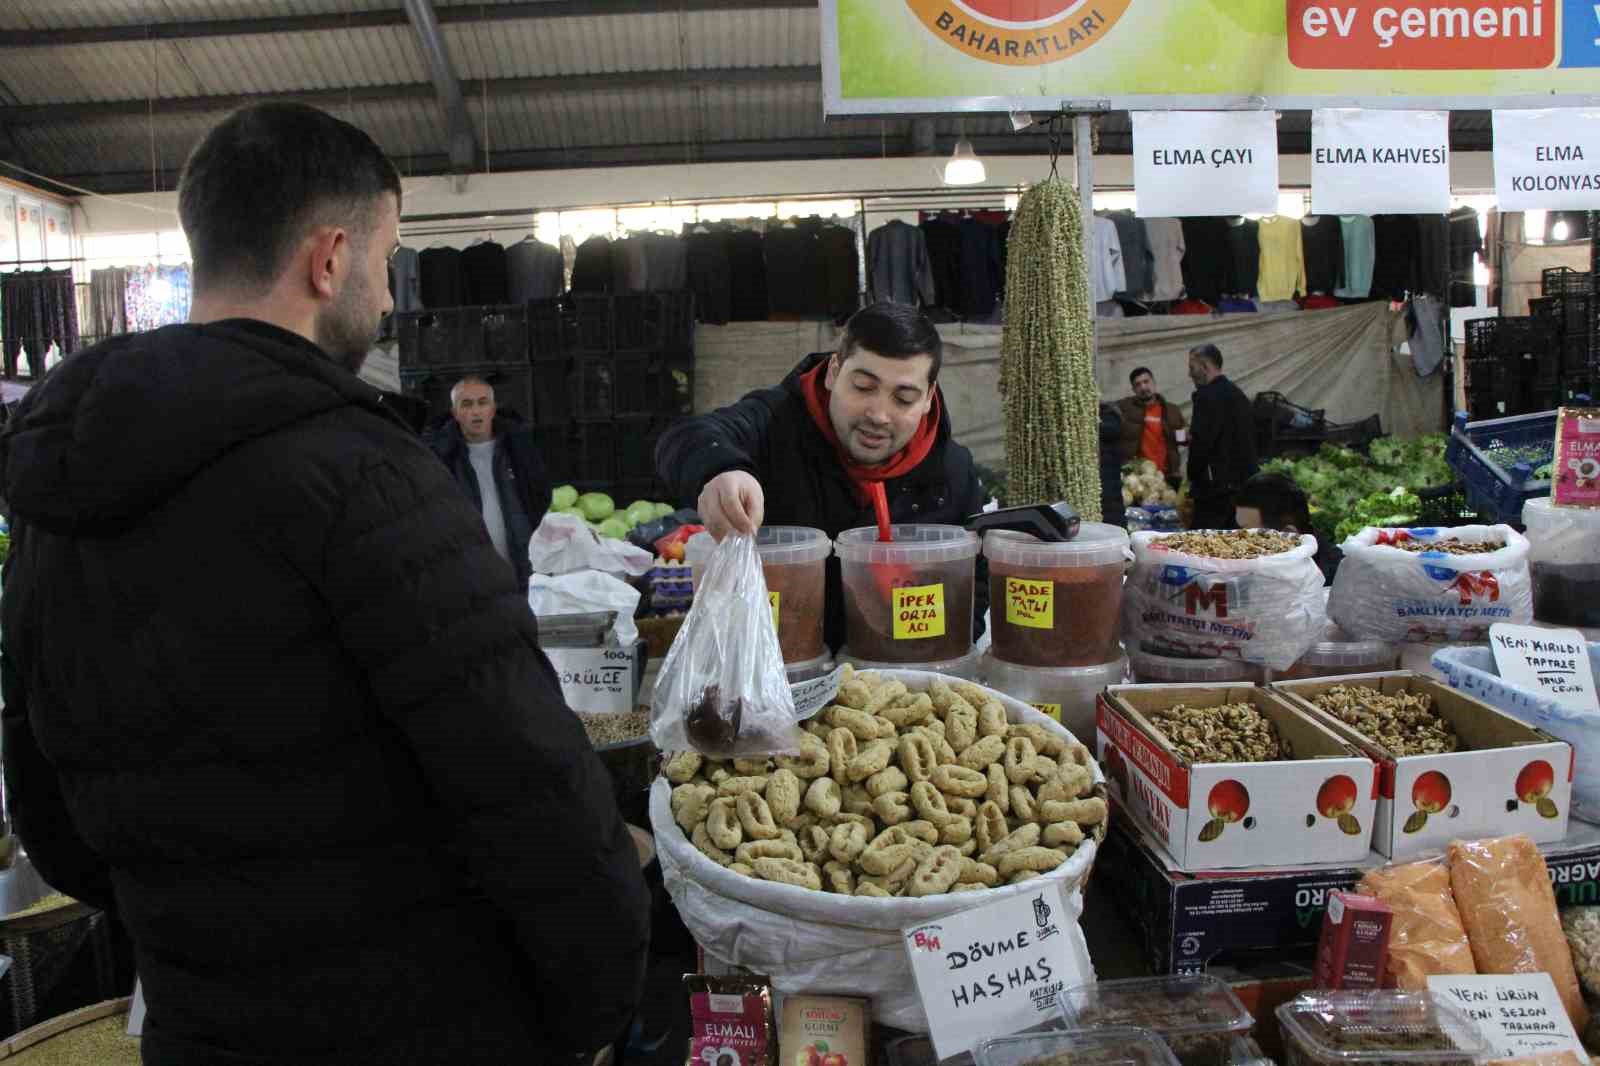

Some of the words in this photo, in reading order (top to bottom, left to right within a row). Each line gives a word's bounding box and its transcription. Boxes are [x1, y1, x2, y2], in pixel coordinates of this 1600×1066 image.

[1302, 6, 1356, 37] ev
[1372, 0, 1542, 48] çemeni
[935, 9, 1105, 58] BAHARATLARI
[1152, 149, 1206, 165] ELMA
[1211, 148, 1253, 169] ÇAYI
[1315, 147, 1367, 164] ELMA
[1372, 145, 1447, 165] KAHVESİ
[1535, 145, 1584, 162] ELMA
[1007, 581, 1050, 597] SADE
[899, 592, 936, 608] İPEK
[1010, 595, 1048, 613] TATLI
[899, 608, 937, 621] ORTA
[906, 622, 930, 634] ACI
[1495, 634, 1528, 649] YENİ
[1531, 640, 1581, 655] KIRILDI
[1525, 656, 1576, 670] TAPTAZE
[946, 931, 1030, 970] DÖVME
[1450, 988, 1489, 1002] YENİ
[1496, 987, 1540, 1001] ÜRÜN
[1500, 1007, 1547, 1018] SEZON
[704, 1023, 756, 1039] ELMALI
[1501, 1021, 1557, 1032] TARHANA
